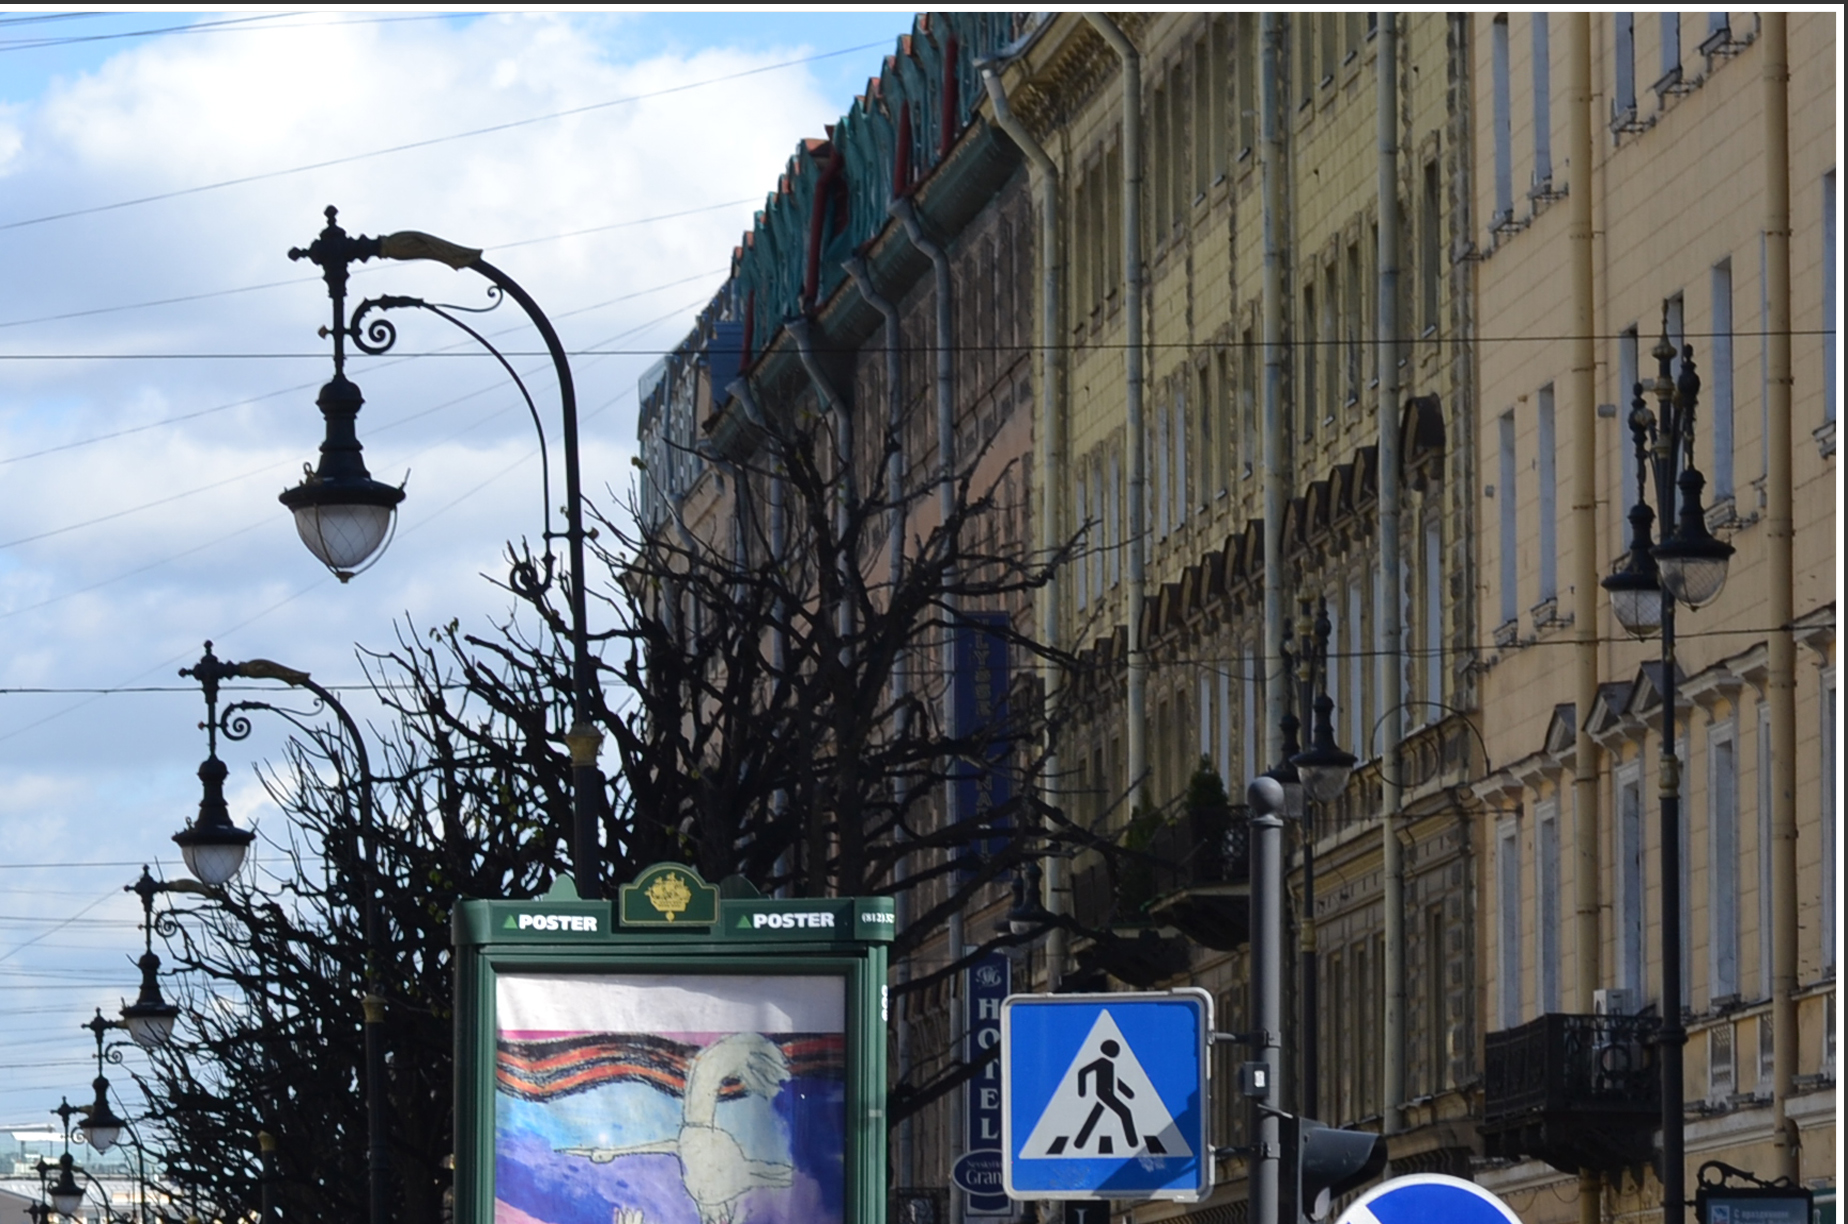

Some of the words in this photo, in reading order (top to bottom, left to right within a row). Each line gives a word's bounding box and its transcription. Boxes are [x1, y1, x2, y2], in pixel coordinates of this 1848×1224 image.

[518, 913, 598, 932] POSTER
[753, 912, 835, 930] POSTER
[965, 1169, 1002, 1185] Gran
